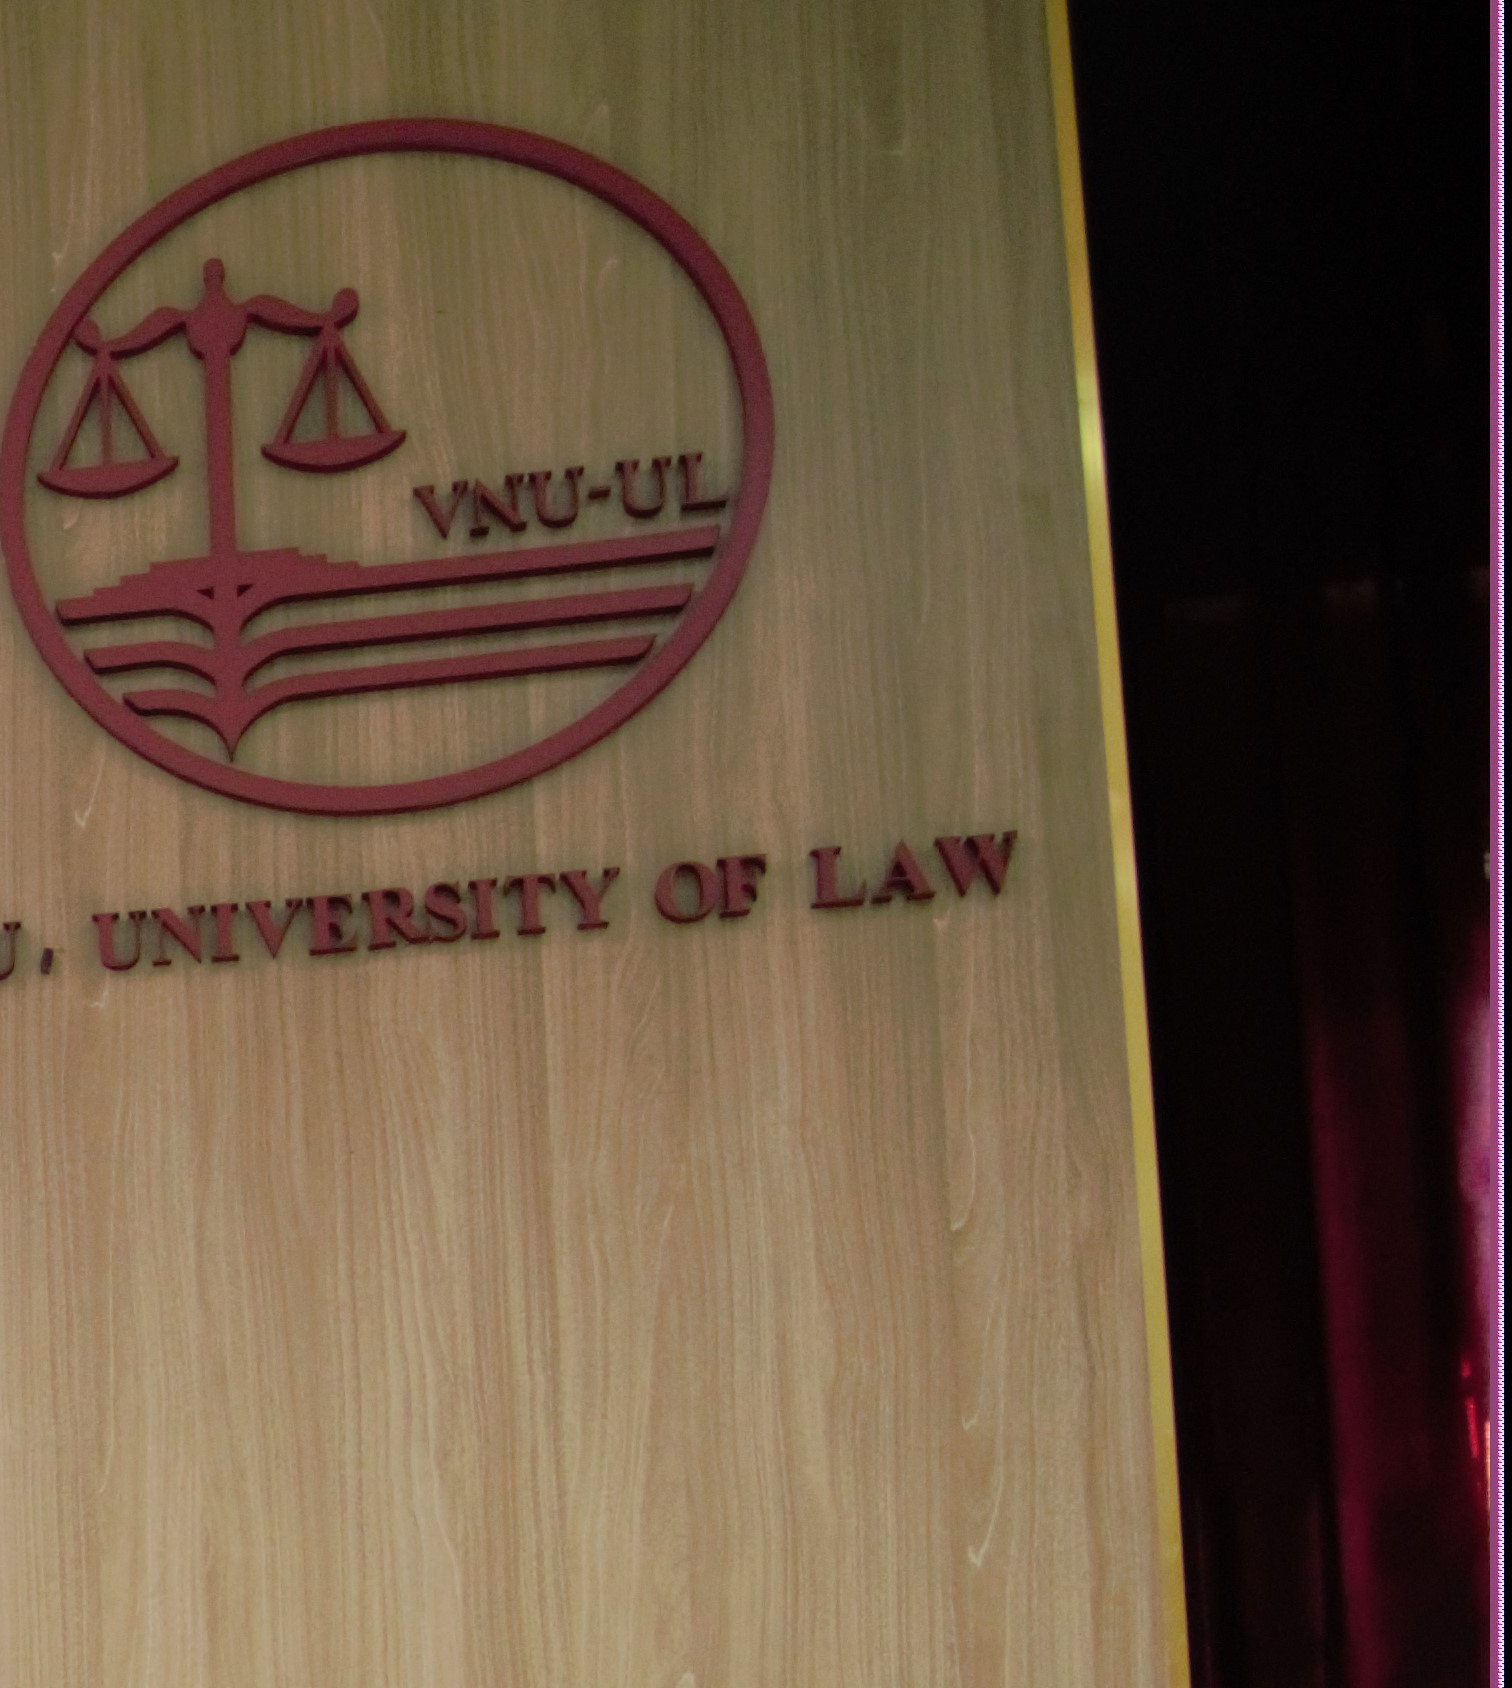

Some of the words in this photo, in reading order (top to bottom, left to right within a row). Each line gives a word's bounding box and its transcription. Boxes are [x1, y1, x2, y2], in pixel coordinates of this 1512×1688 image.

[414, 452, 727, 540] VNU-UL
[92, 867, 620, 974] UNIVERSITY
[654, 854, 766, 924] OF
[810, 830, 1017, 911] LAW
